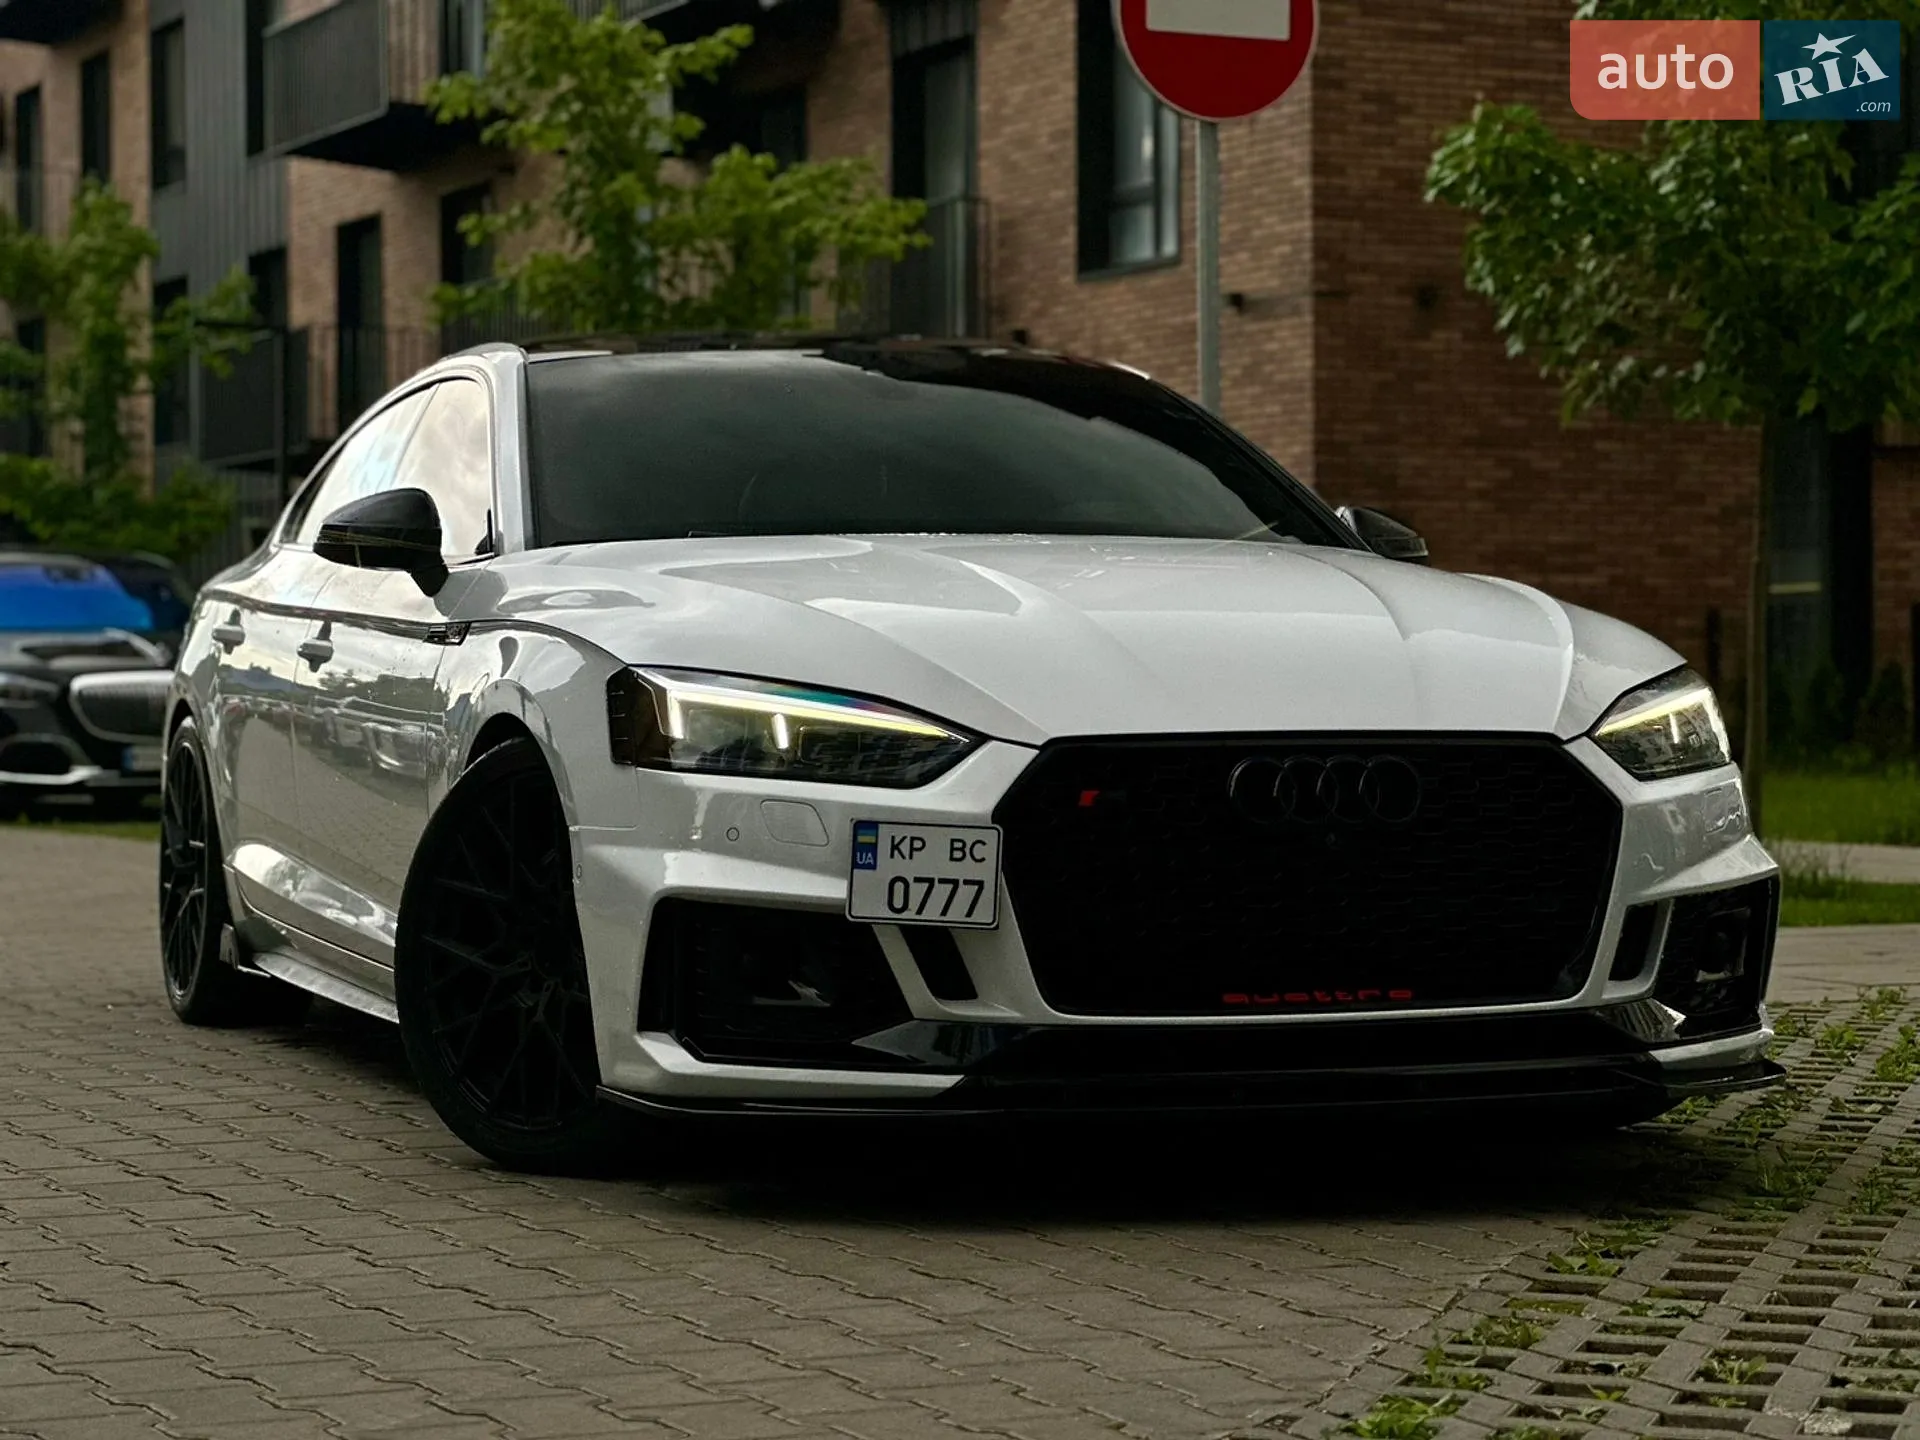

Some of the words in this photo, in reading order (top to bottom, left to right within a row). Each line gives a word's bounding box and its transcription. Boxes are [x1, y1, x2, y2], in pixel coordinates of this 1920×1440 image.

[856, 851, 874, 865] UA
[889, 835, 926, 861] KP
[949, 838, 987, 863] BC
[887, 875, 985, 918] 0777
[1222, 990, 1413, 1004] quattro
